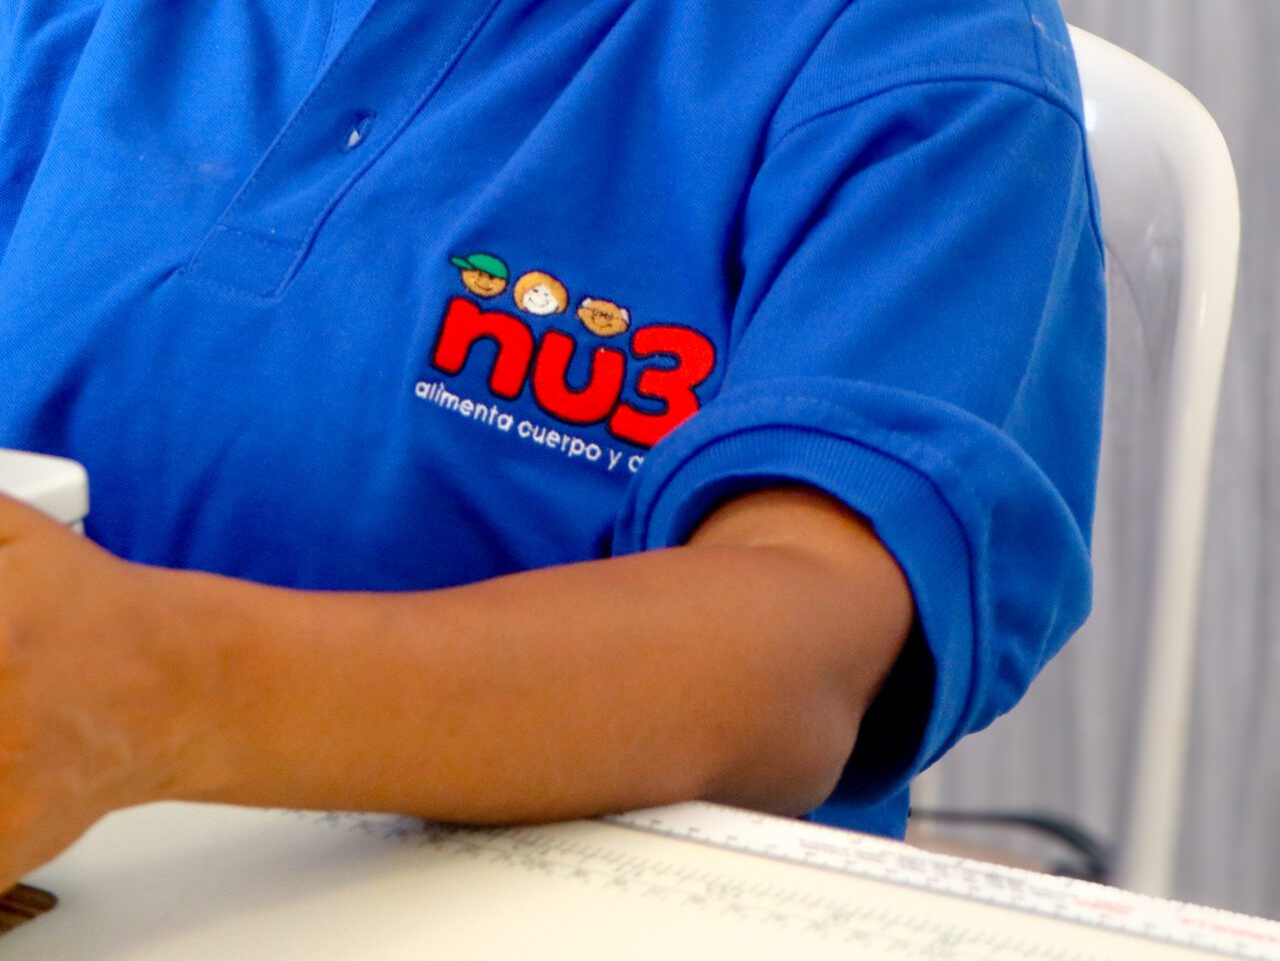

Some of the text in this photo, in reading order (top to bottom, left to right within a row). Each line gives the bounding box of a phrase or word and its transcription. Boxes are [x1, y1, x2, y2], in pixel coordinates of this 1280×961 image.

[414, 380, 514, 431] alimenta
[517, 419, 602, 463] cuerpo
[607, 448, 622, 472] y
